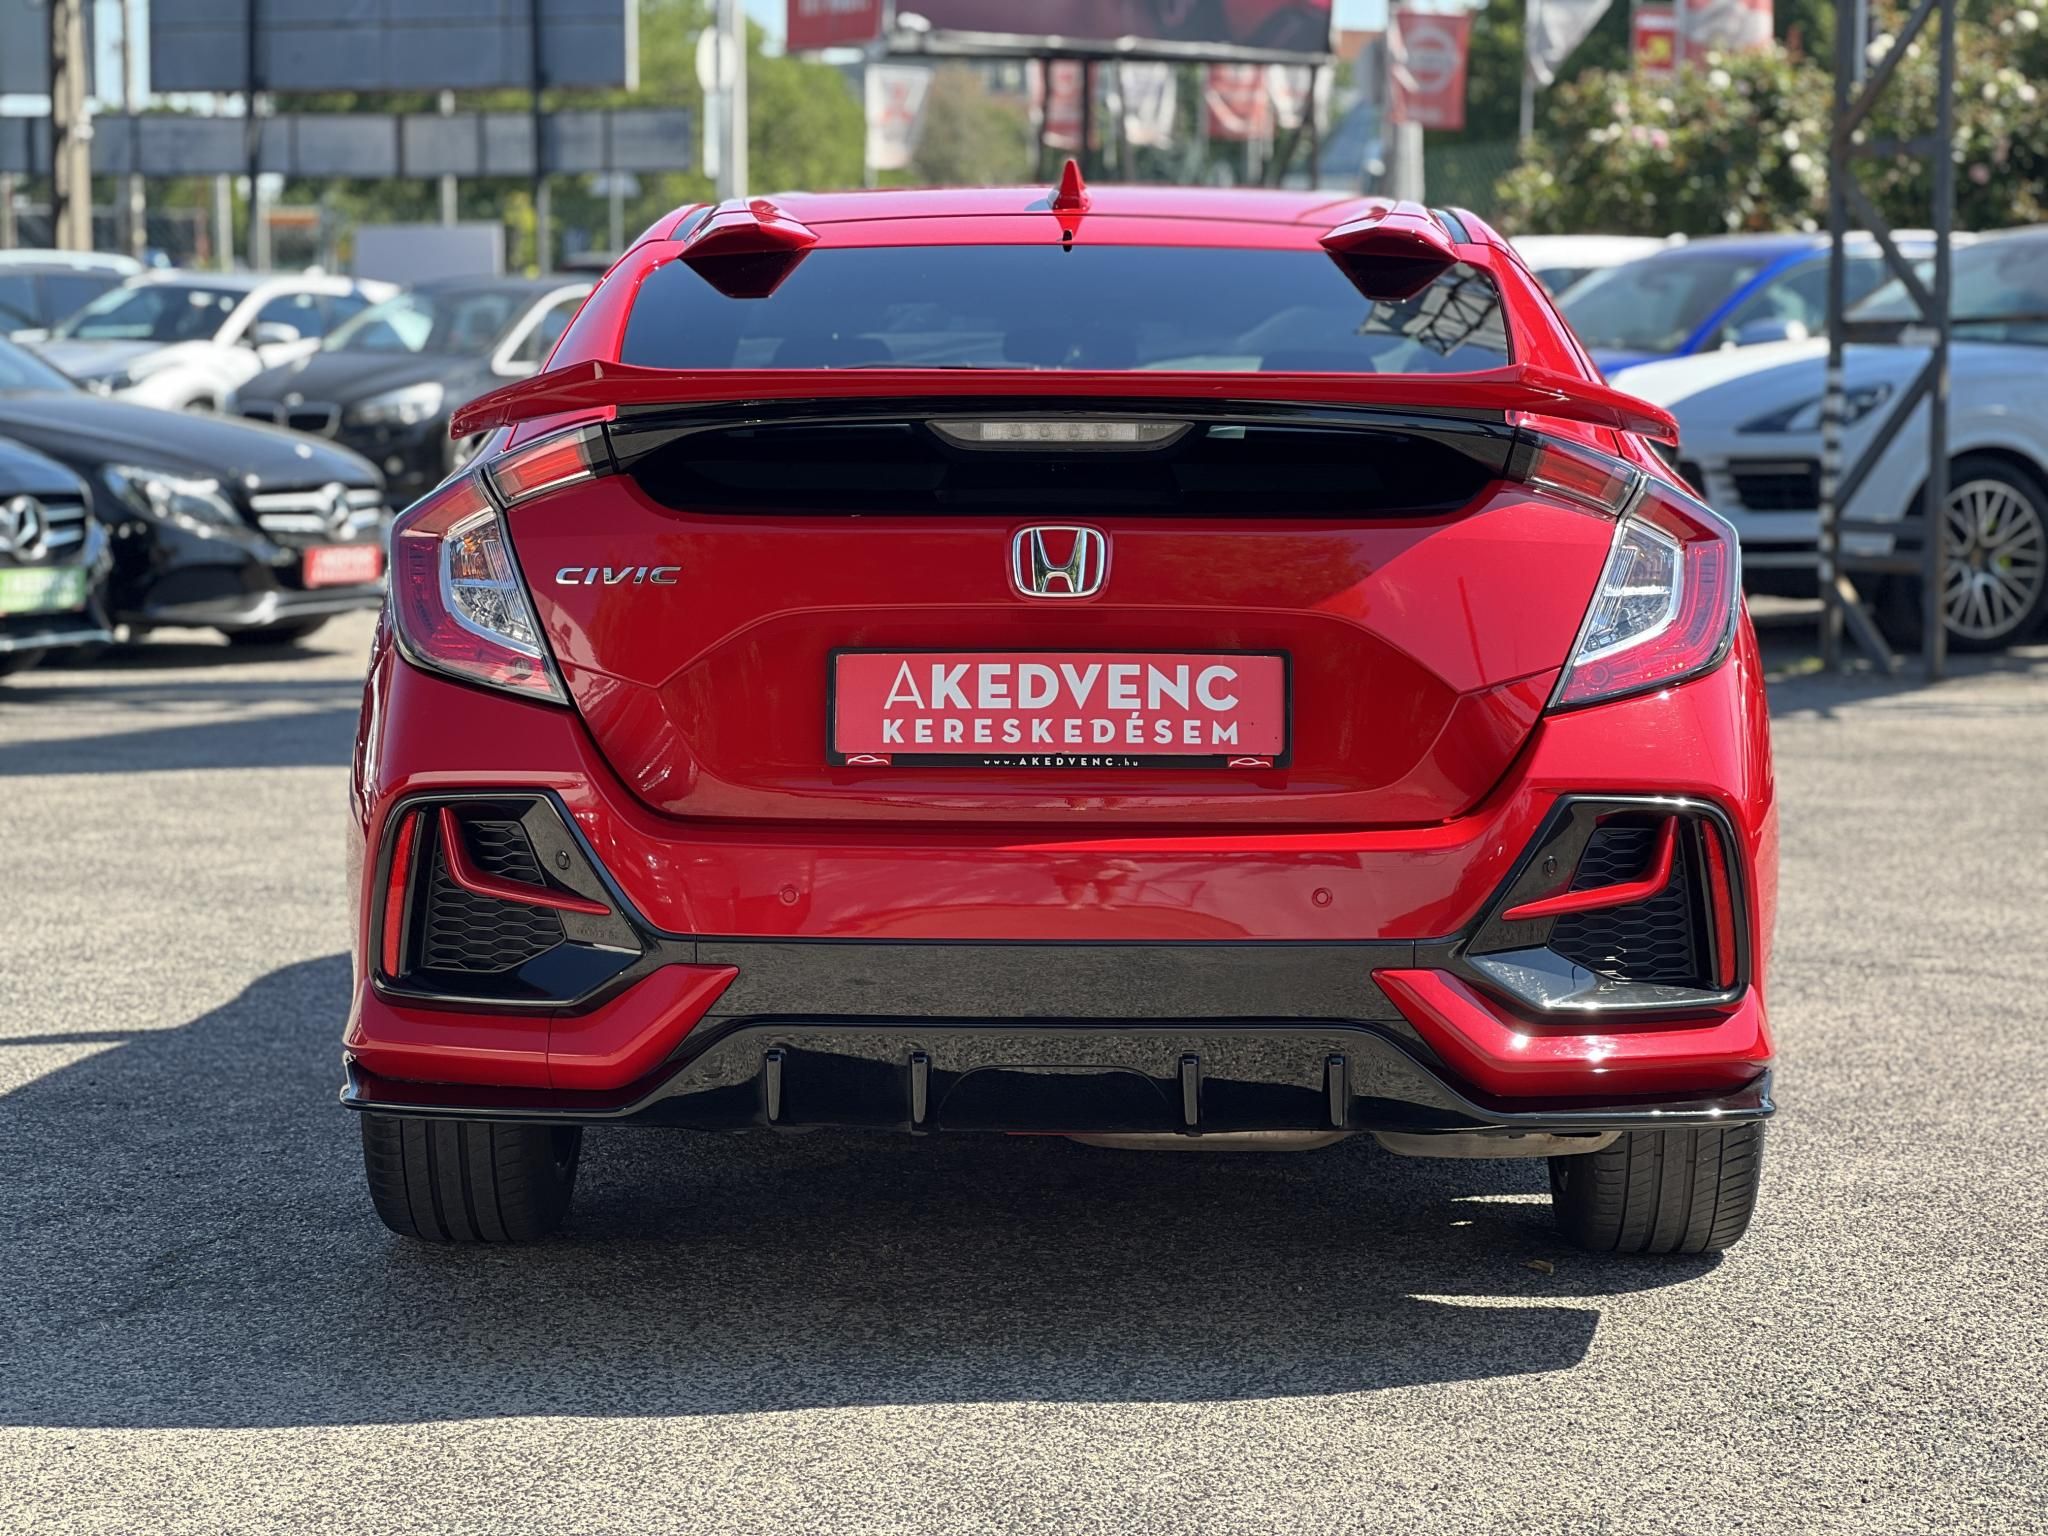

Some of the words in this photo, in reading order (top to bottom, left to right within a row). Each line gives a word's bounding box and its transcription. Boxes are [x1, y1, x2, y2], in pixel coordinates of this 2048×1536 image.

[555, 566, 682, 585] CIVIC
[882, 712, 1239, 745] KERESKEDÉSEM
[984, 757, 1139, 767] www.AKEDVENC.hu
